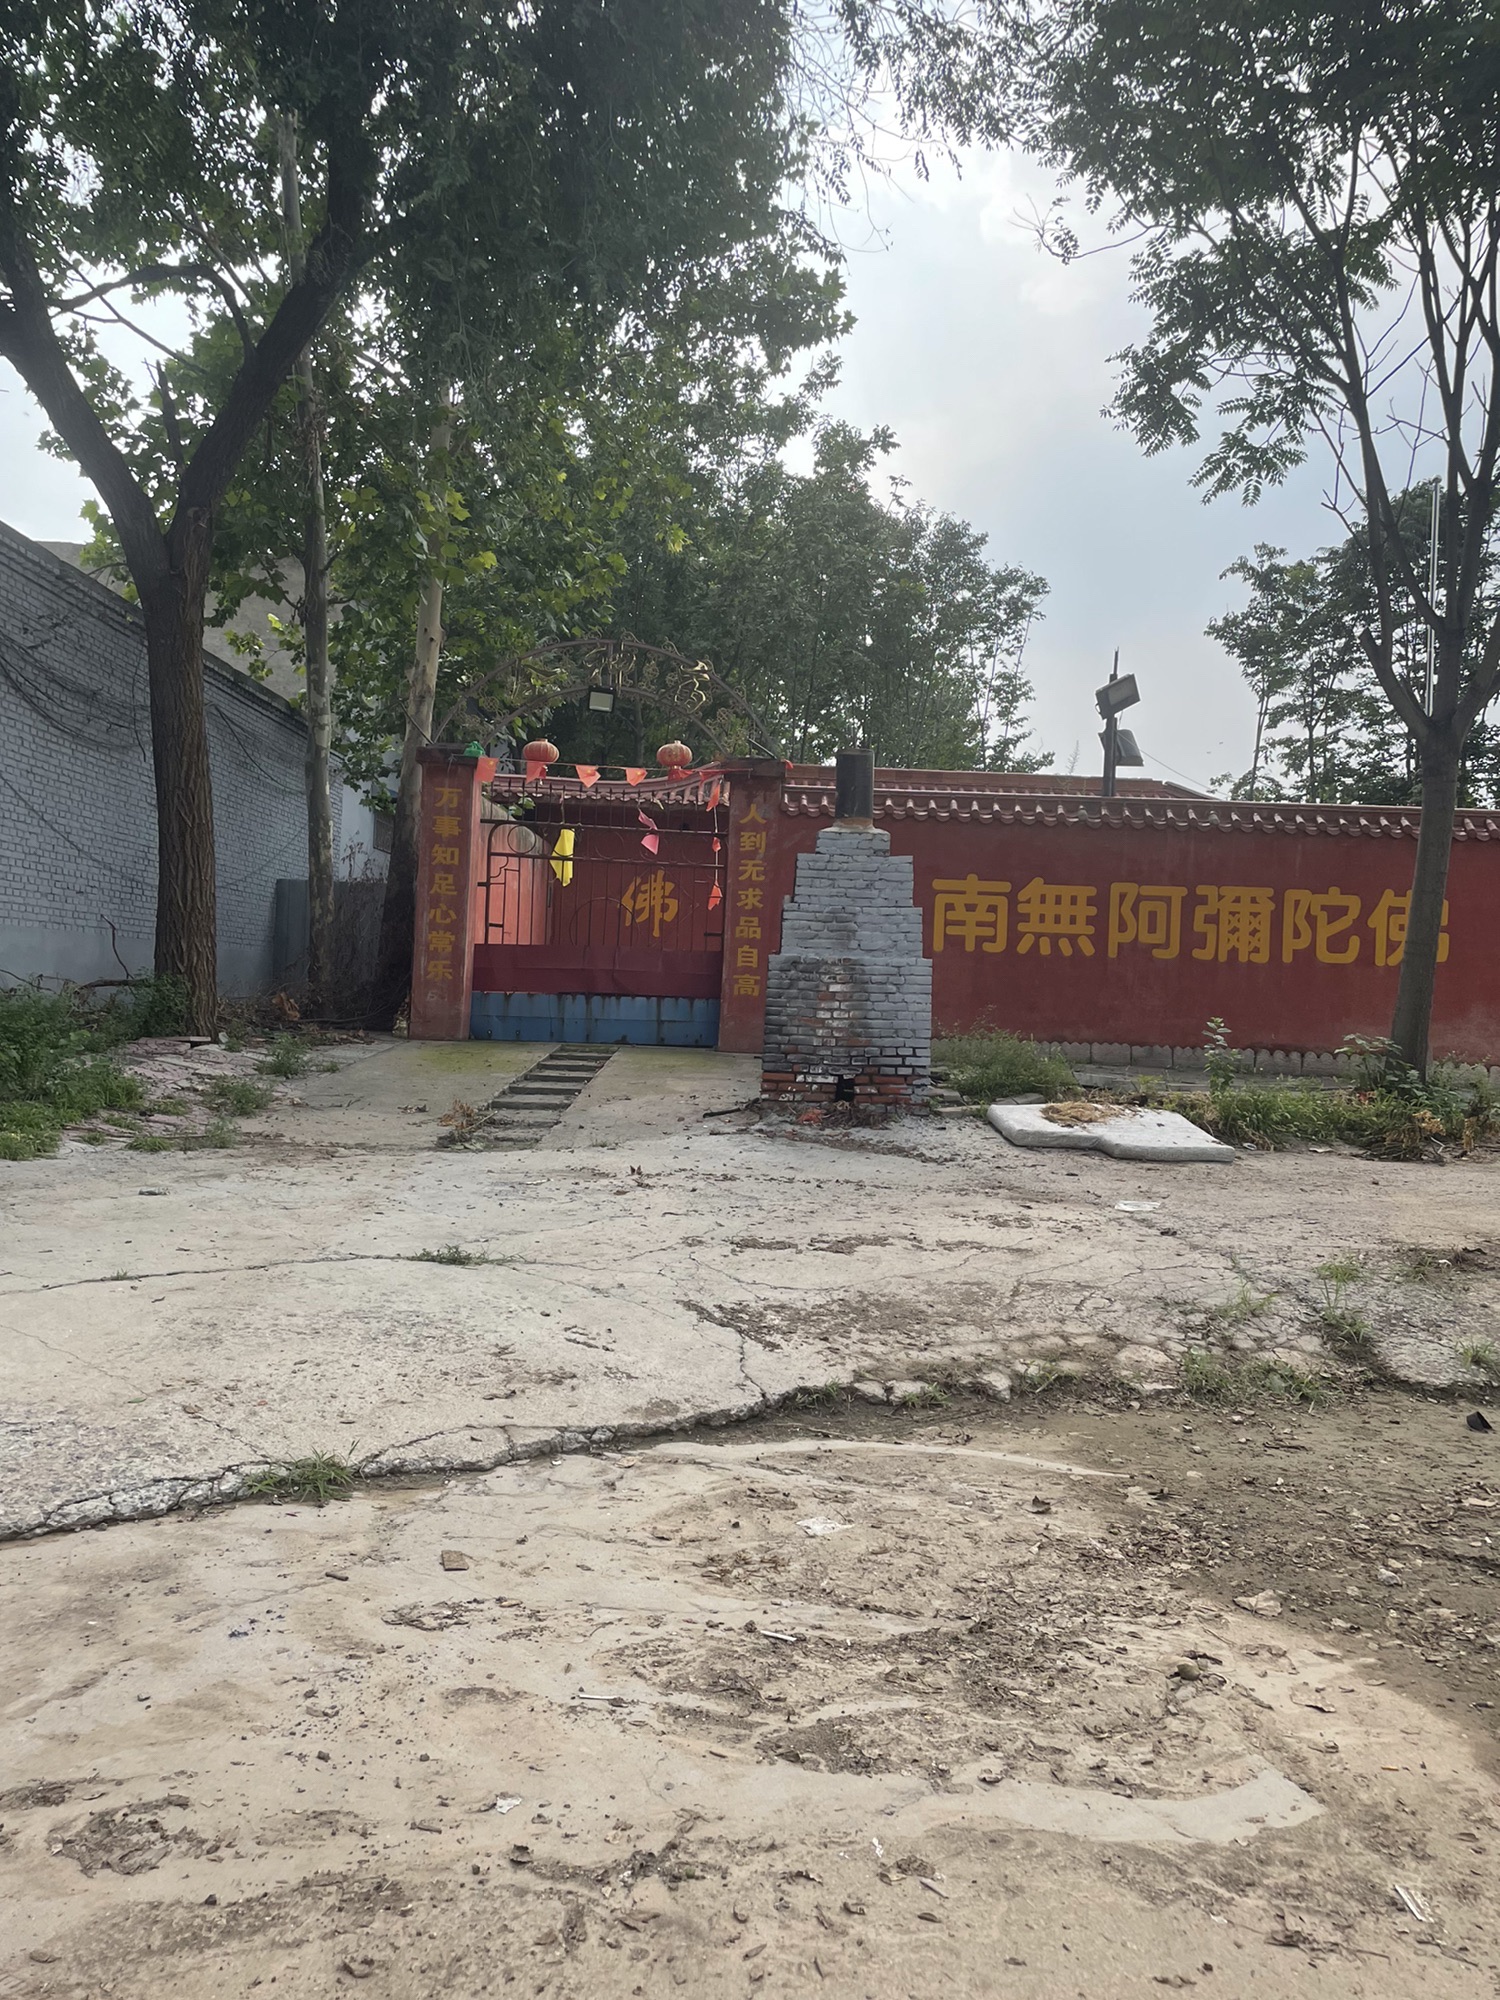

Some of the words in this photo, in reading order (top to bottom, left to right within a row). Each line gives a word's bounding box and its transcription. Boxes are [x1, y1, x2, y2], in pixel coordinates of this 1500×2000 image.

[427, 786, 462, 981] 万事知足心常乐
[618, 869, 679, 938] 佛
[733, 803, 767, 997] 人到无求品自高
